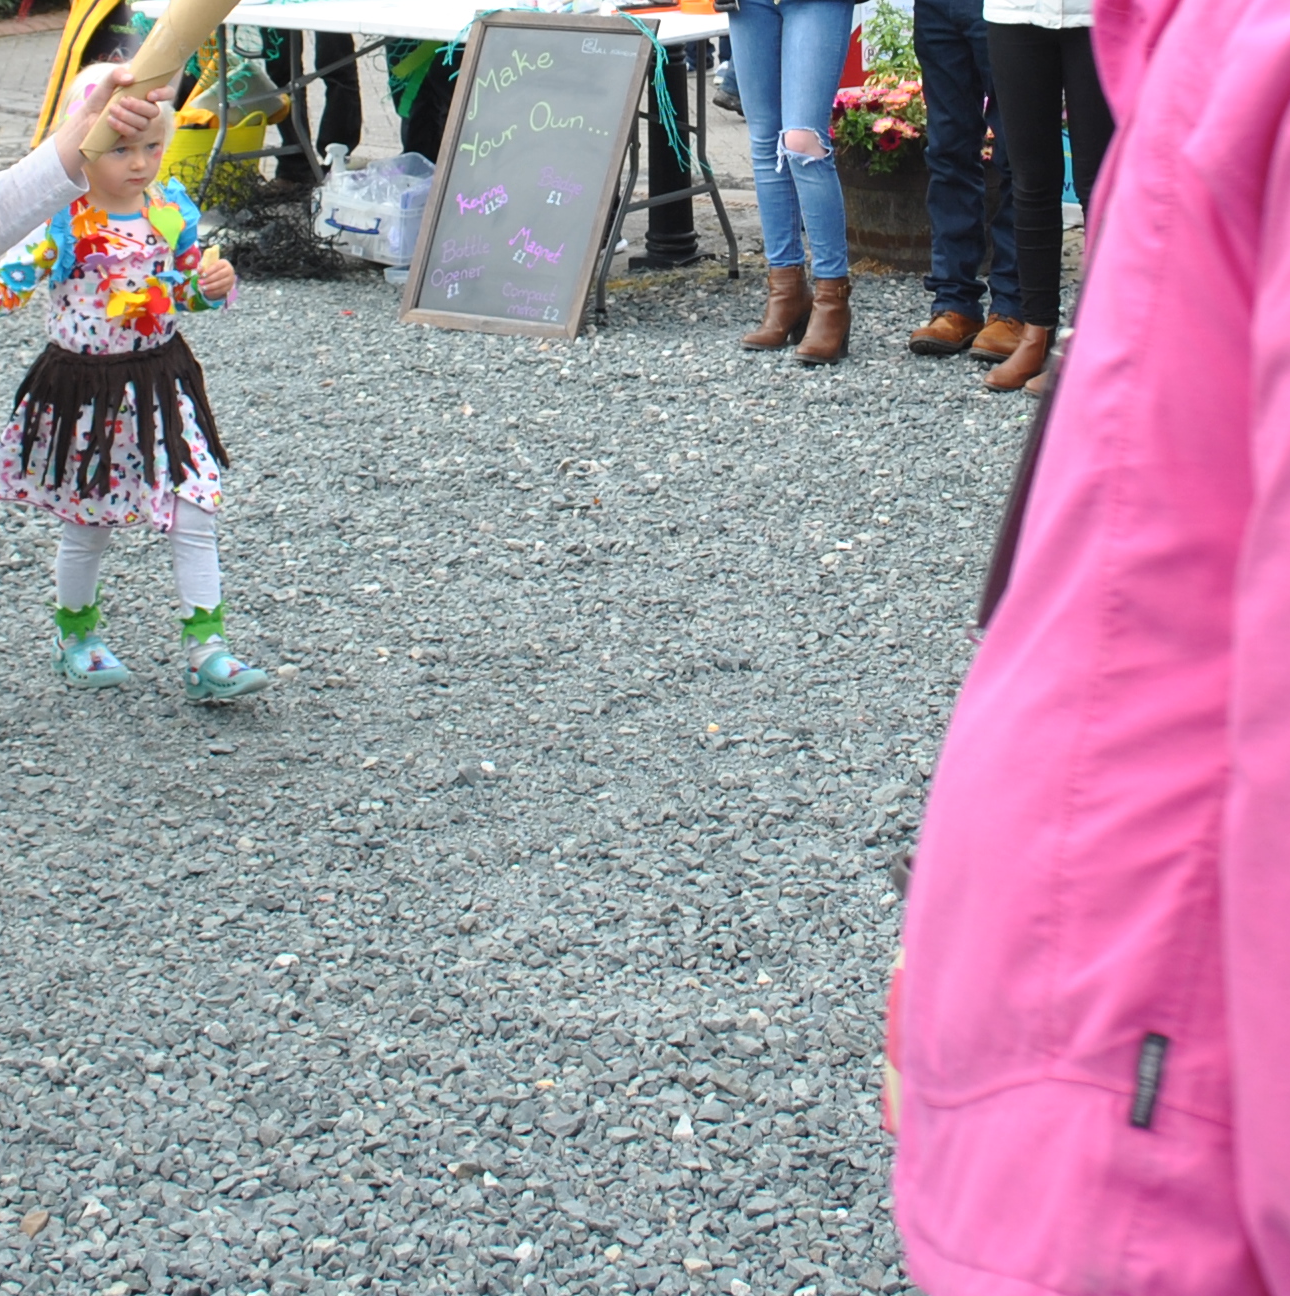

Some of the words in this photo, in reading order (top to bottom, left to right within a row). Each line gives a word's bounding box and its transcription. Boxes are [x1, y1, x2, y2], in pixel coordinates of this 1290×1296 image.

[468, 49, 554, 120] Make
[460, 124, 517, 166] Your
[538, 166, 583, 203] Badge
[456, 184, 505, 215] Keyring
[546, 190, 562, 206] £1
[441, 234, 491, 263] Bottle
[509, 226, 565, 269] Magnet
[512, 249, 527, 264] £1
[431, 264, 485, 288] Opener
[447, 283, 460, 299] £1
[502, 282, 558, 303] Compact
[542, 305, 559, 321] £2
